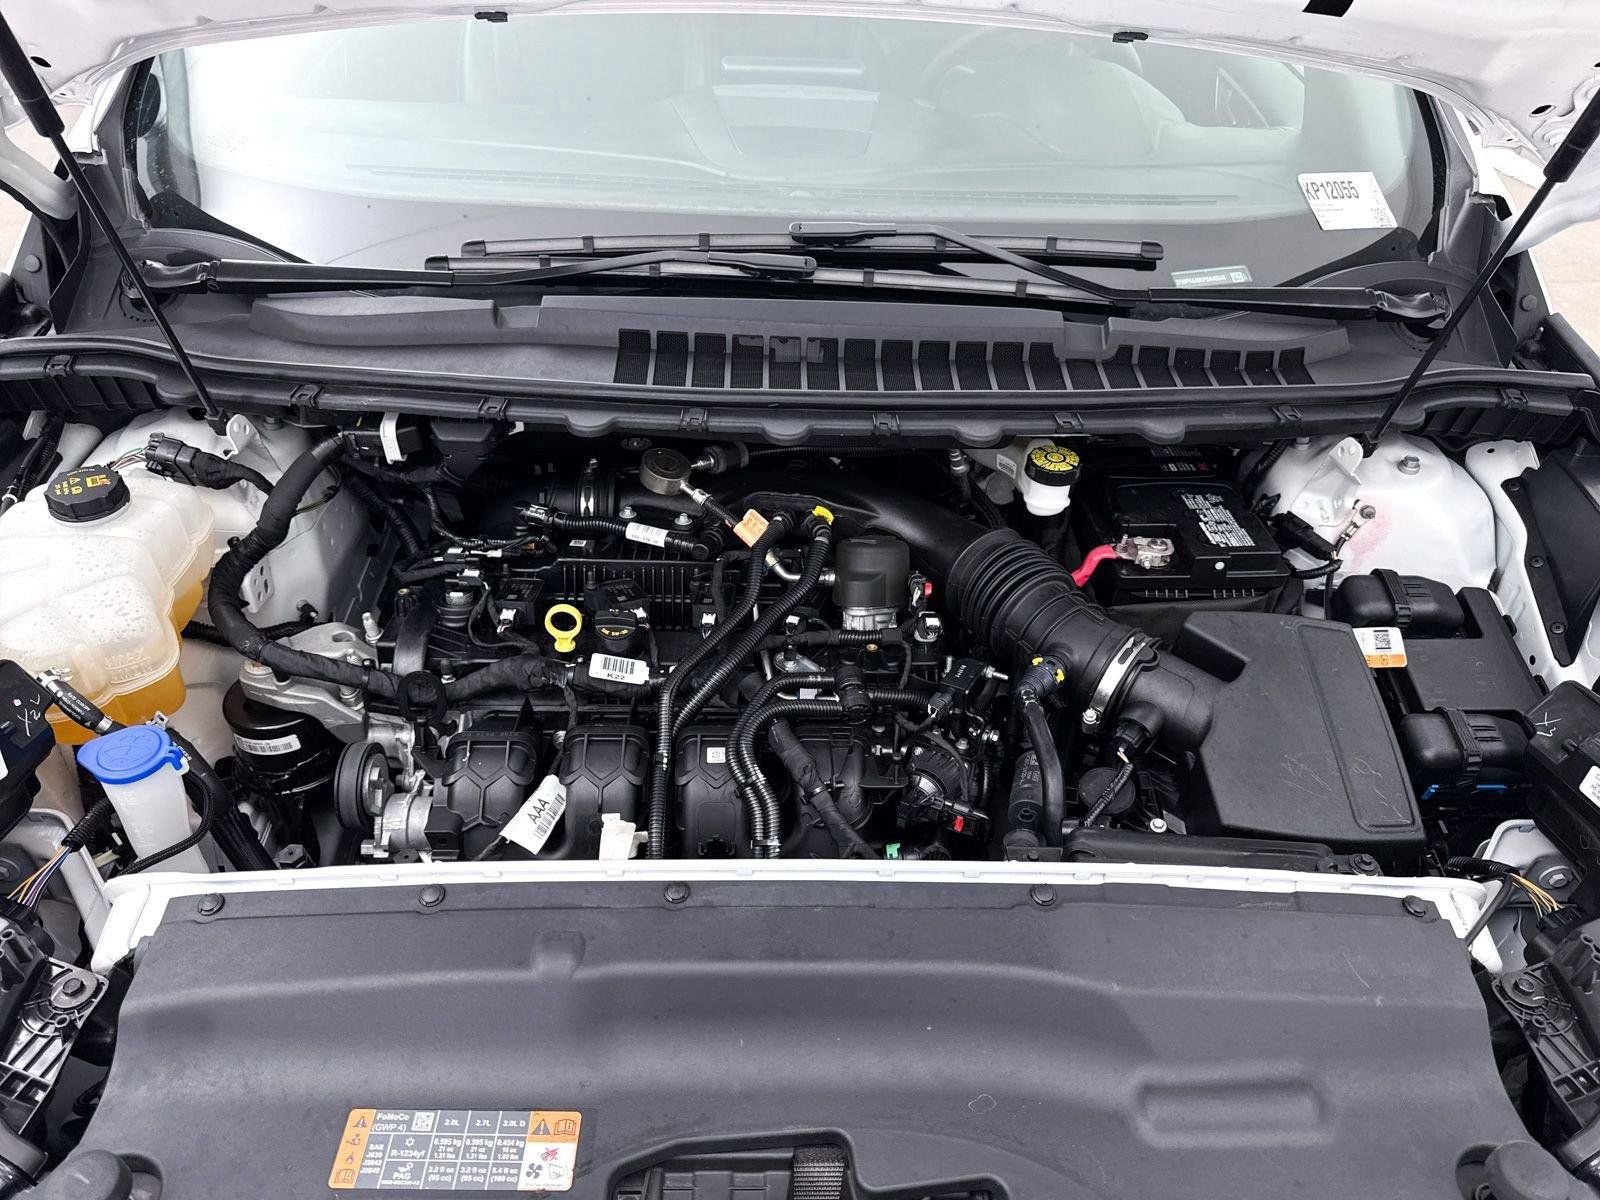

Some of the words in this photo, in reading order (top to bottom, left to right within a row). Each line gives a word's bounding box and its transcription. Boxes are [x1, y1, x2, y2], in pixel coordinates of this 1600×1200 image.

[1304, 180, 1359, 201] KP12055
[606, 672, 626, 681] K22
[527, 798, 550, 824] AAA
[376, 1112, 410, 1121] FoMoCo
[444, 1119, 460, 1127] 2.0L
[475, 1119, 491, 1127] 2.7L
[372, 1123, 396, 1132] (GWP
[397, 1123, 407, 1133] 4)
[453, 1138, 462, 1147] kg
[485, 1138, 494, 1147] kg
[516, 1139, 525, 1148] kg
[390, 1149, 425, 1160] R-1234yf
